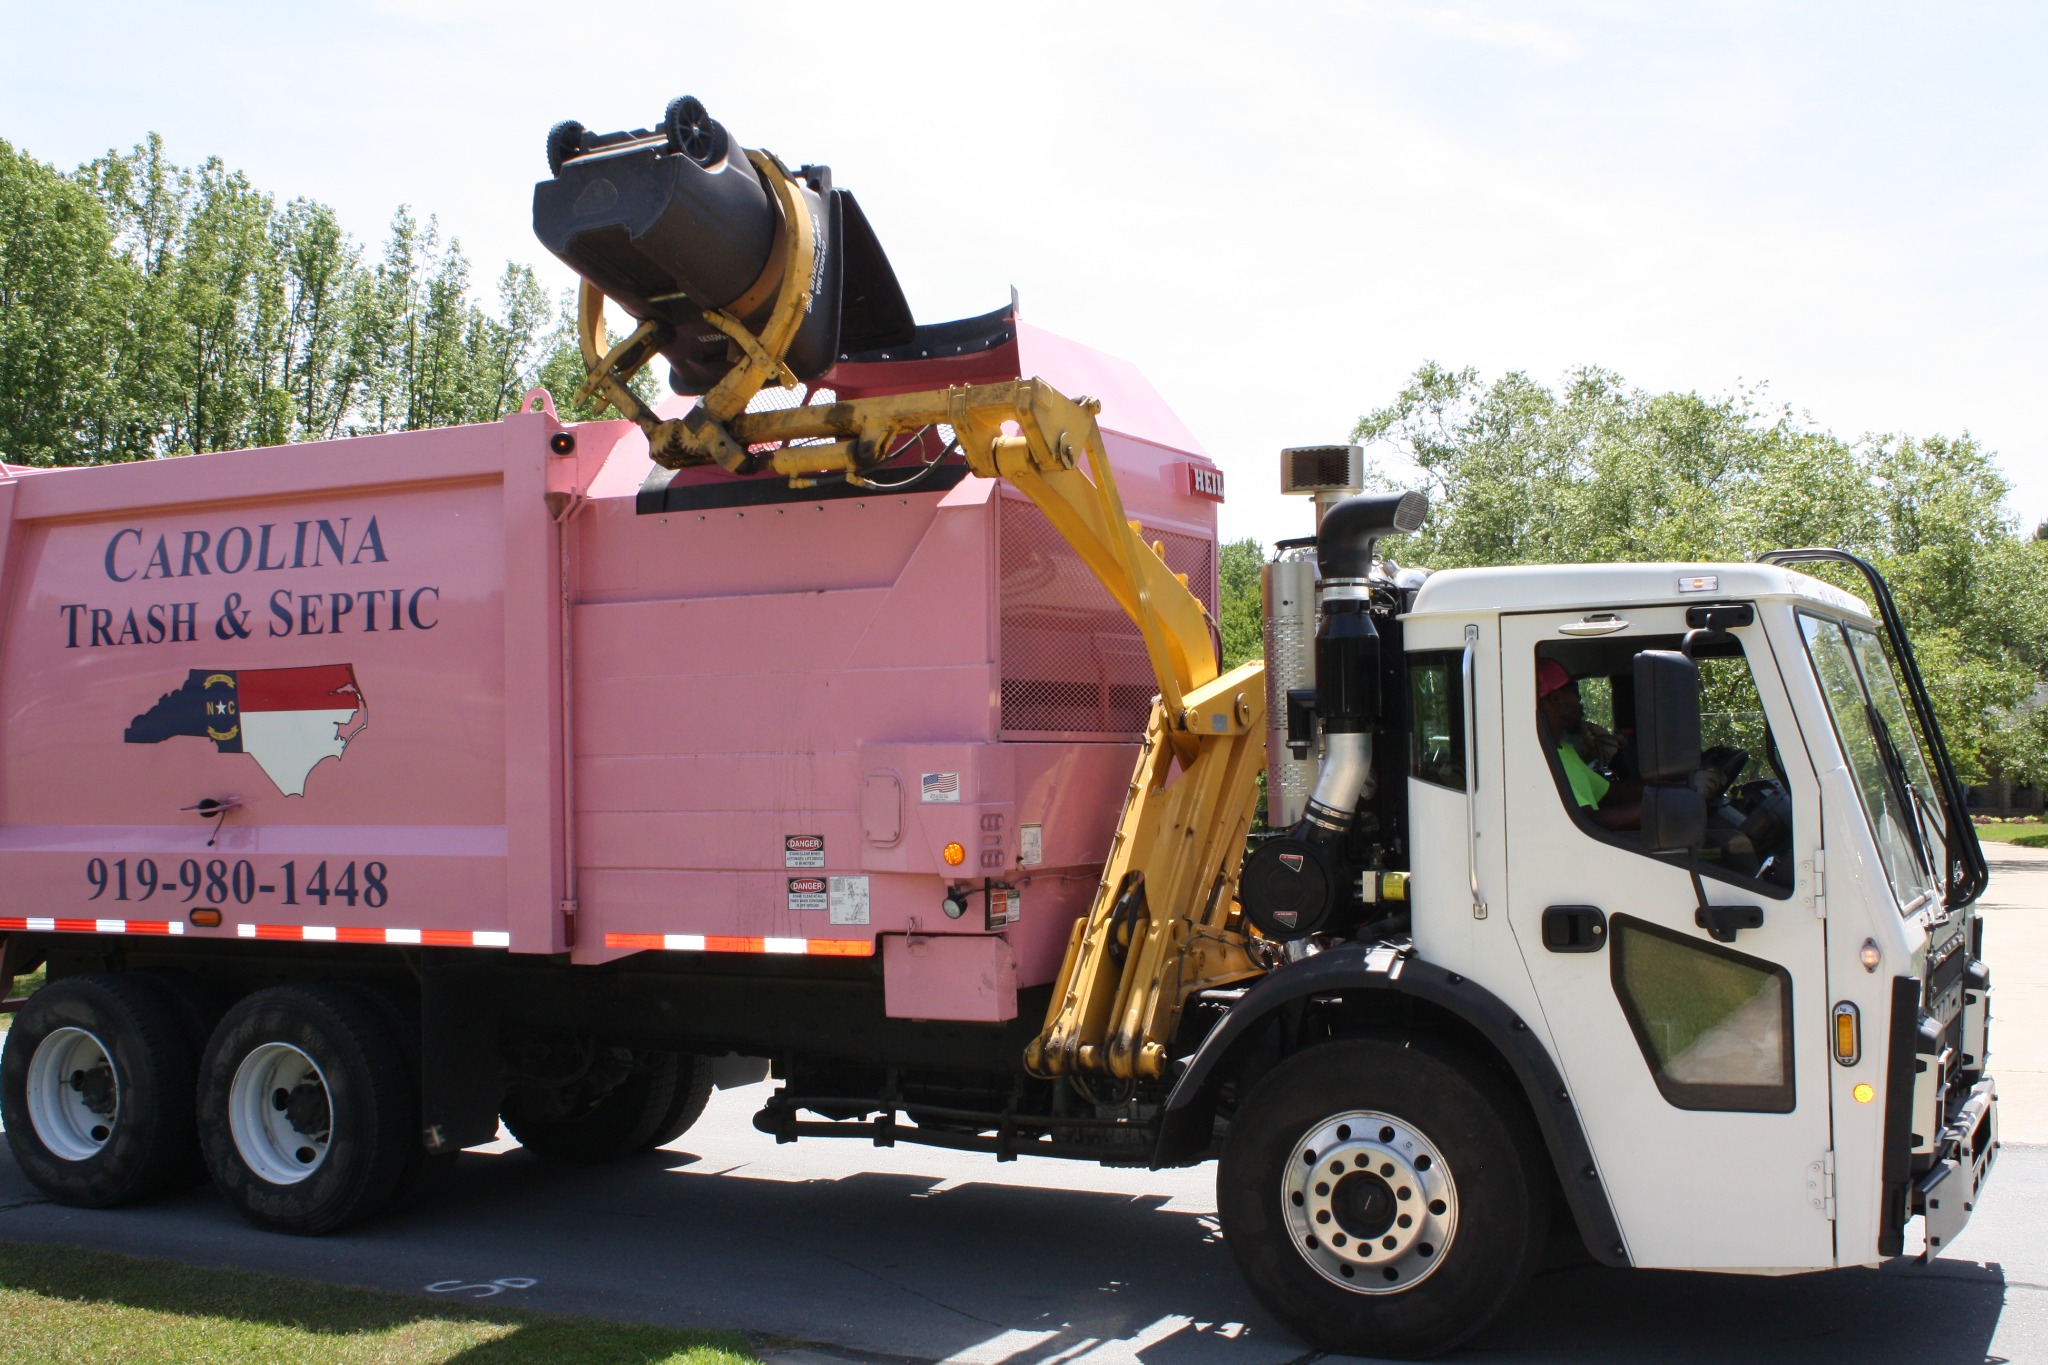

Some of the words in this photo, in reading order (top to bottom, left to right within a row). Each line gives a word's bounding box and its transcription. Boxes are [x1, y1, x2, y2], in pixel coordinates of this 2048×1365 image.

[815, 240, 826, 295] CAROLINA
[1194, 468, 1225, 498] HEIL
[104, 514, 390, 583] CAROLINA
[60, 602, 200, 649] TRASH
[214, 592, 253, 641] &
[268, 586, 440, 638] SEPTIC
[206, 701, 215, 716] N
[227, 700, 236, 716] C
[789, 839, 820, 848] DANGER
[86, 857, 389, 908] 919-980-1448
[793, 882, 822, 891] DANGER
